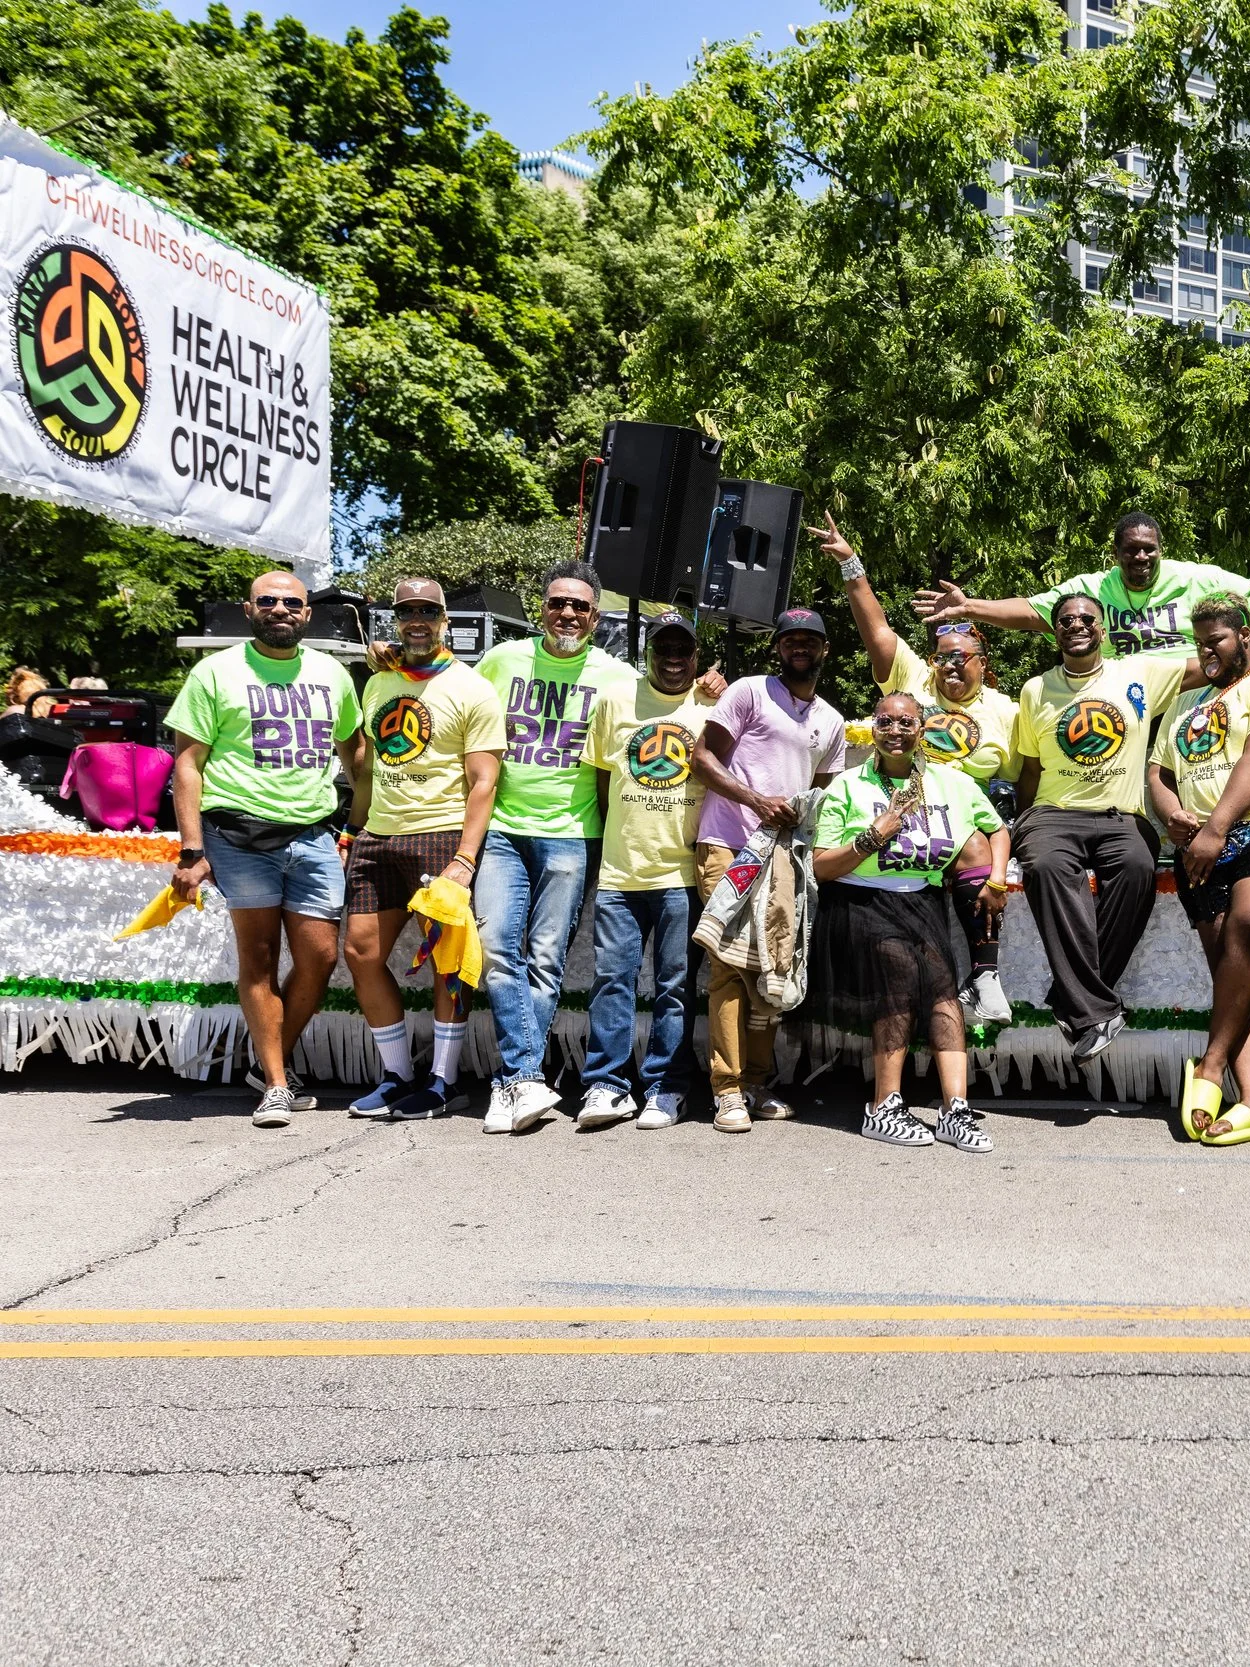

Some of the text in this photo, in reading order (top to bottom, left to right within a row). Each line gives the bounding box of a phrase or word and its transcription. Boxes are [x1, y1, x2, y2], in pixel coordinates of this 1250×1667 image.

[46, 175, 302, 326] CHIWELLNESSCIRCLE.COM
[17, 265, 48, 338] MIND
[124, 283, 152, 356] PROJECT VIDA
[110, 282, 146, 364] BODY
[9, 329, 21, 382] CHICAGO
[172, 305, 308, 407] HEALTH &
[142, 366, 153, 427] TASK FORCE
[170, 364, 321, 466] WELLNESS
[18, 392, 46, 442] ALLIANCE
[59, 424, 112, 458] SOUL
[170, 426, 272, 502] CIRCLE
[1107, 602, 1178, 632] DON'T
[247, 683, 333, 720] DON'T
[506, 676, 597, 721] DON'T
[251, 719, 333, 749] DIE
[505, 714, 589, 750] DIE
[253, 749, 333, 769] HIGH
[502, 745, 582, 768] HIGH
[1089, 768, 1127, 777] WELLNESS
[386, 772, 428, 782] WELLNESS
[647, 780, 674, 788] SOUL
[1191, 771, 1216, 783] CIRCLE
[621, 794, 696, 807] HEALTH & WELLNESS
[645, 804, 673, 812] CIRCLE
[873, 801, 953, 839] DN'T
